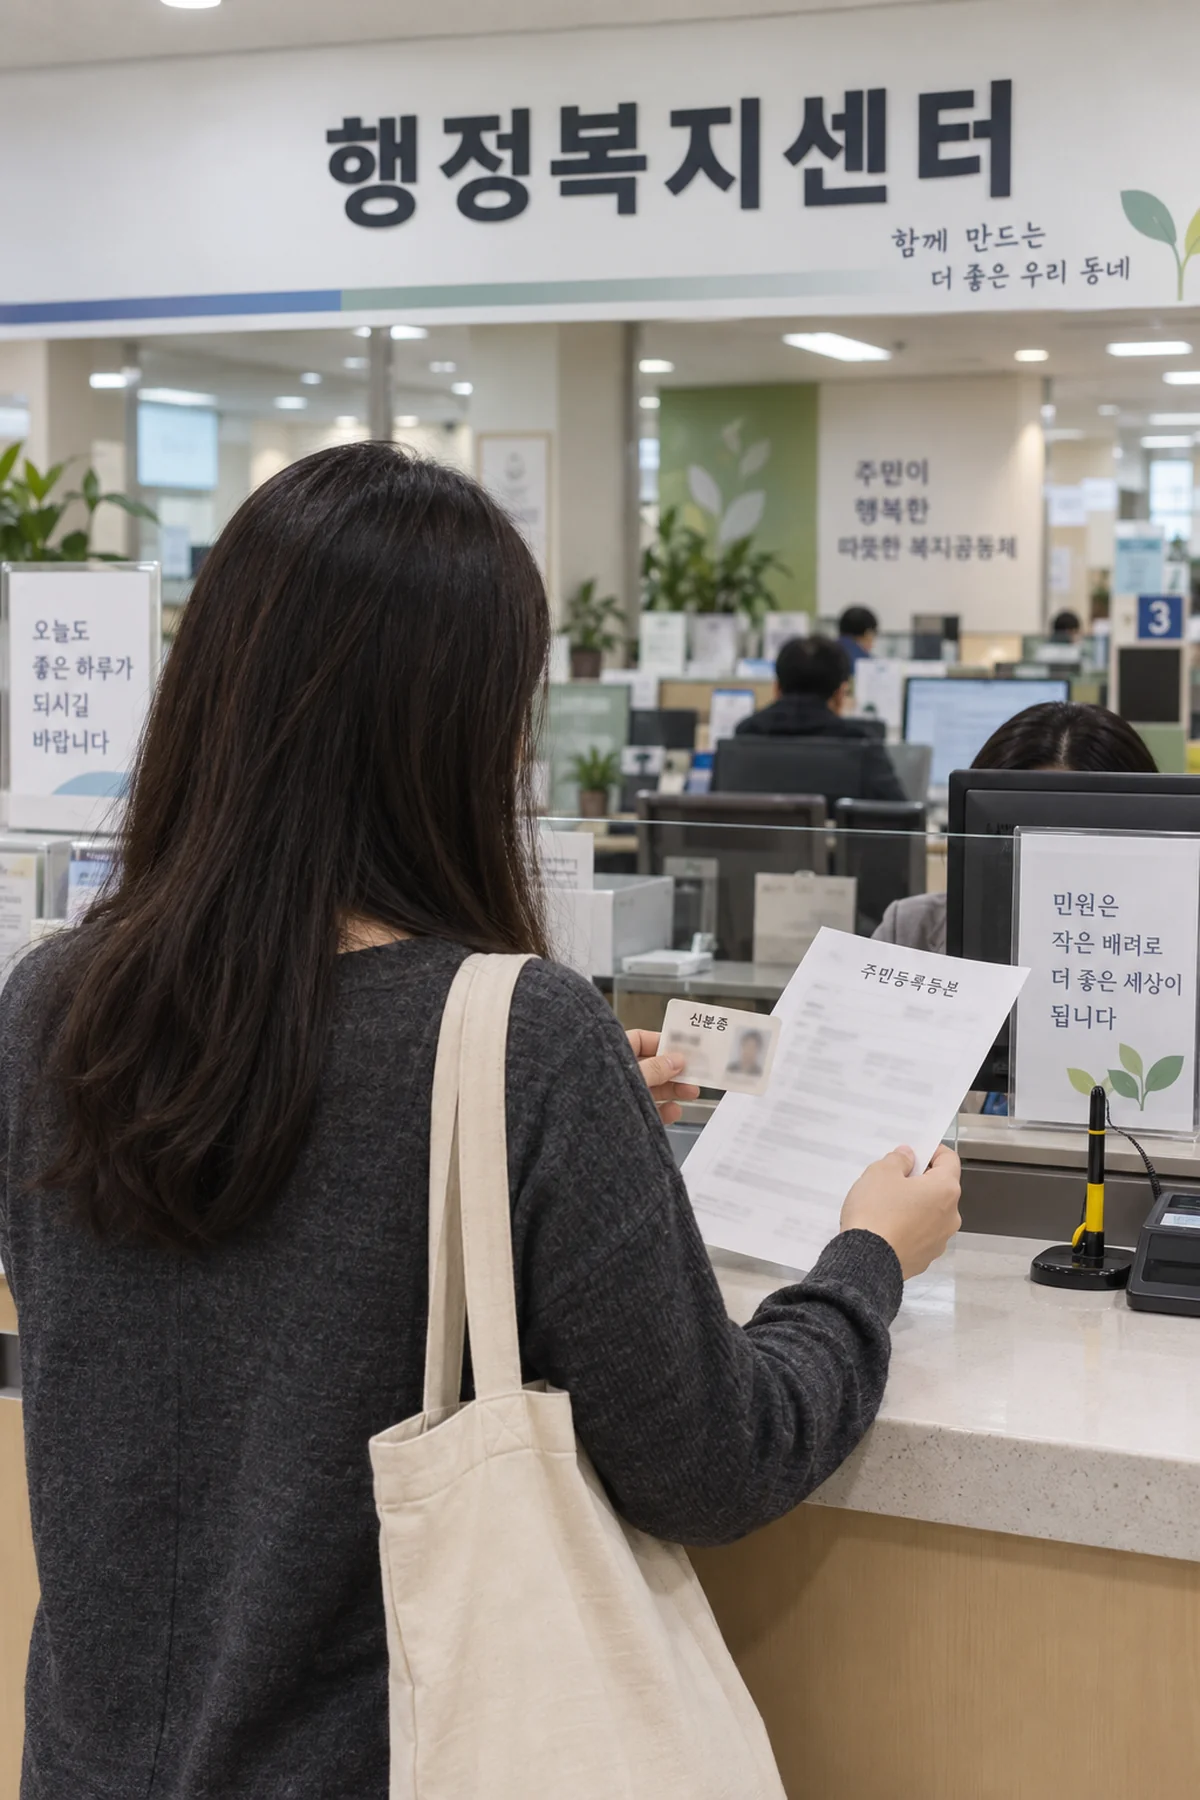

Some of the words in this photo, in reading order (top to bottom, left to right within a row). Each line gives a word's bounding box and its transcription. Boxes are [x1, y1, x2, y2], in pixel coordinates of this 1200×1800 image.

[325, 78, 1013, 229] 행정복지센터
[891, 228, 948, 258] 함께
[966, 221, 1046, 253] 만드는
[931, 266, 951, 290] 더
[963, 263, 1010, 292] 좋은
[1020, 260, 1066, 288] 우리
[1080, 255, 1130, 285] 동네
[855, 458, 929, 487] 주민이
[855, 497, 929, 525] 행복한
[837, 535, 902, 561] 따뜻한
[32, 619, 90, 643] 오늘도
[1147, 600, 1171, 636] 3
[32, 655, 70, 681] 좋은
[76, 655, 134, 681] 하루가
[33, 692, 89, 718] 되시길
[33, 729, 109, 755] 바랍니다
[1053, 891, 1120, 918] 민원은
[1051, 929, 1095, 955] 작은
[1102, 932, 1164, 957] 배려로
[860, 963, 959, 998] 주민등록등본
[1051, 967, 1070, 990] 더
[1077, 968, 1118, 993] 좋은
[1123, 971, 1182, 996] 세상이
[690, 1013, 728, 1031] 신분증
[1050, 1003, 1117, 1031] 됩니다
